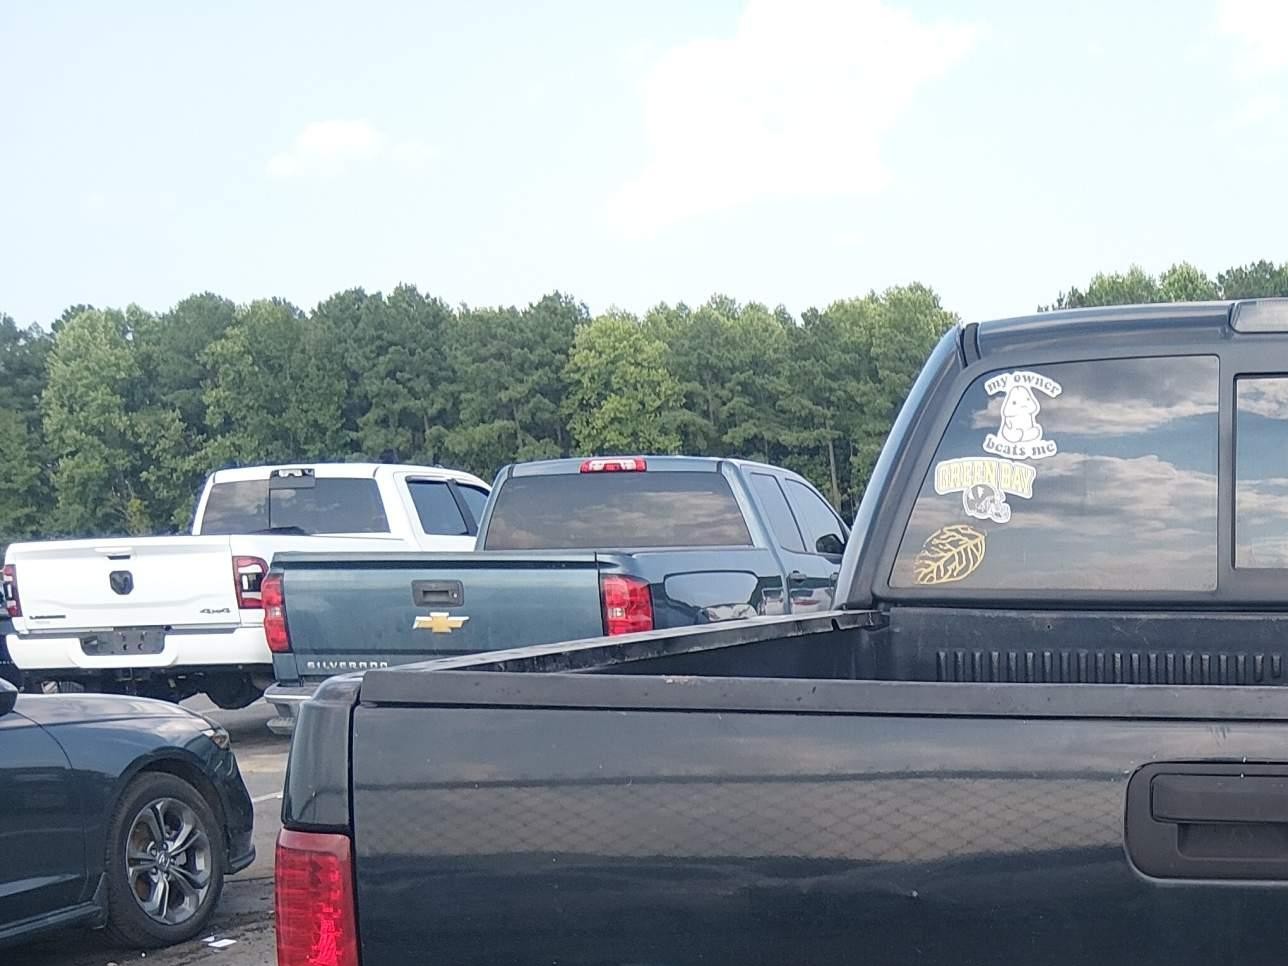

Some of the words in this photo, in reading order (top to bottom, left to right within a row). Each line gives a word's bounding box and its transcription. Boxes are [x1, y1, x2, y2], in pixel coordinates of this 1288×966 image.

[986, 376, 1009, 394] my
[986, 437, 1026, 456] beats
[1031, 440, 1057, 456] me
[939, 459, 999, 491] GREEN
[999, 461, 1036, 496] BAY
